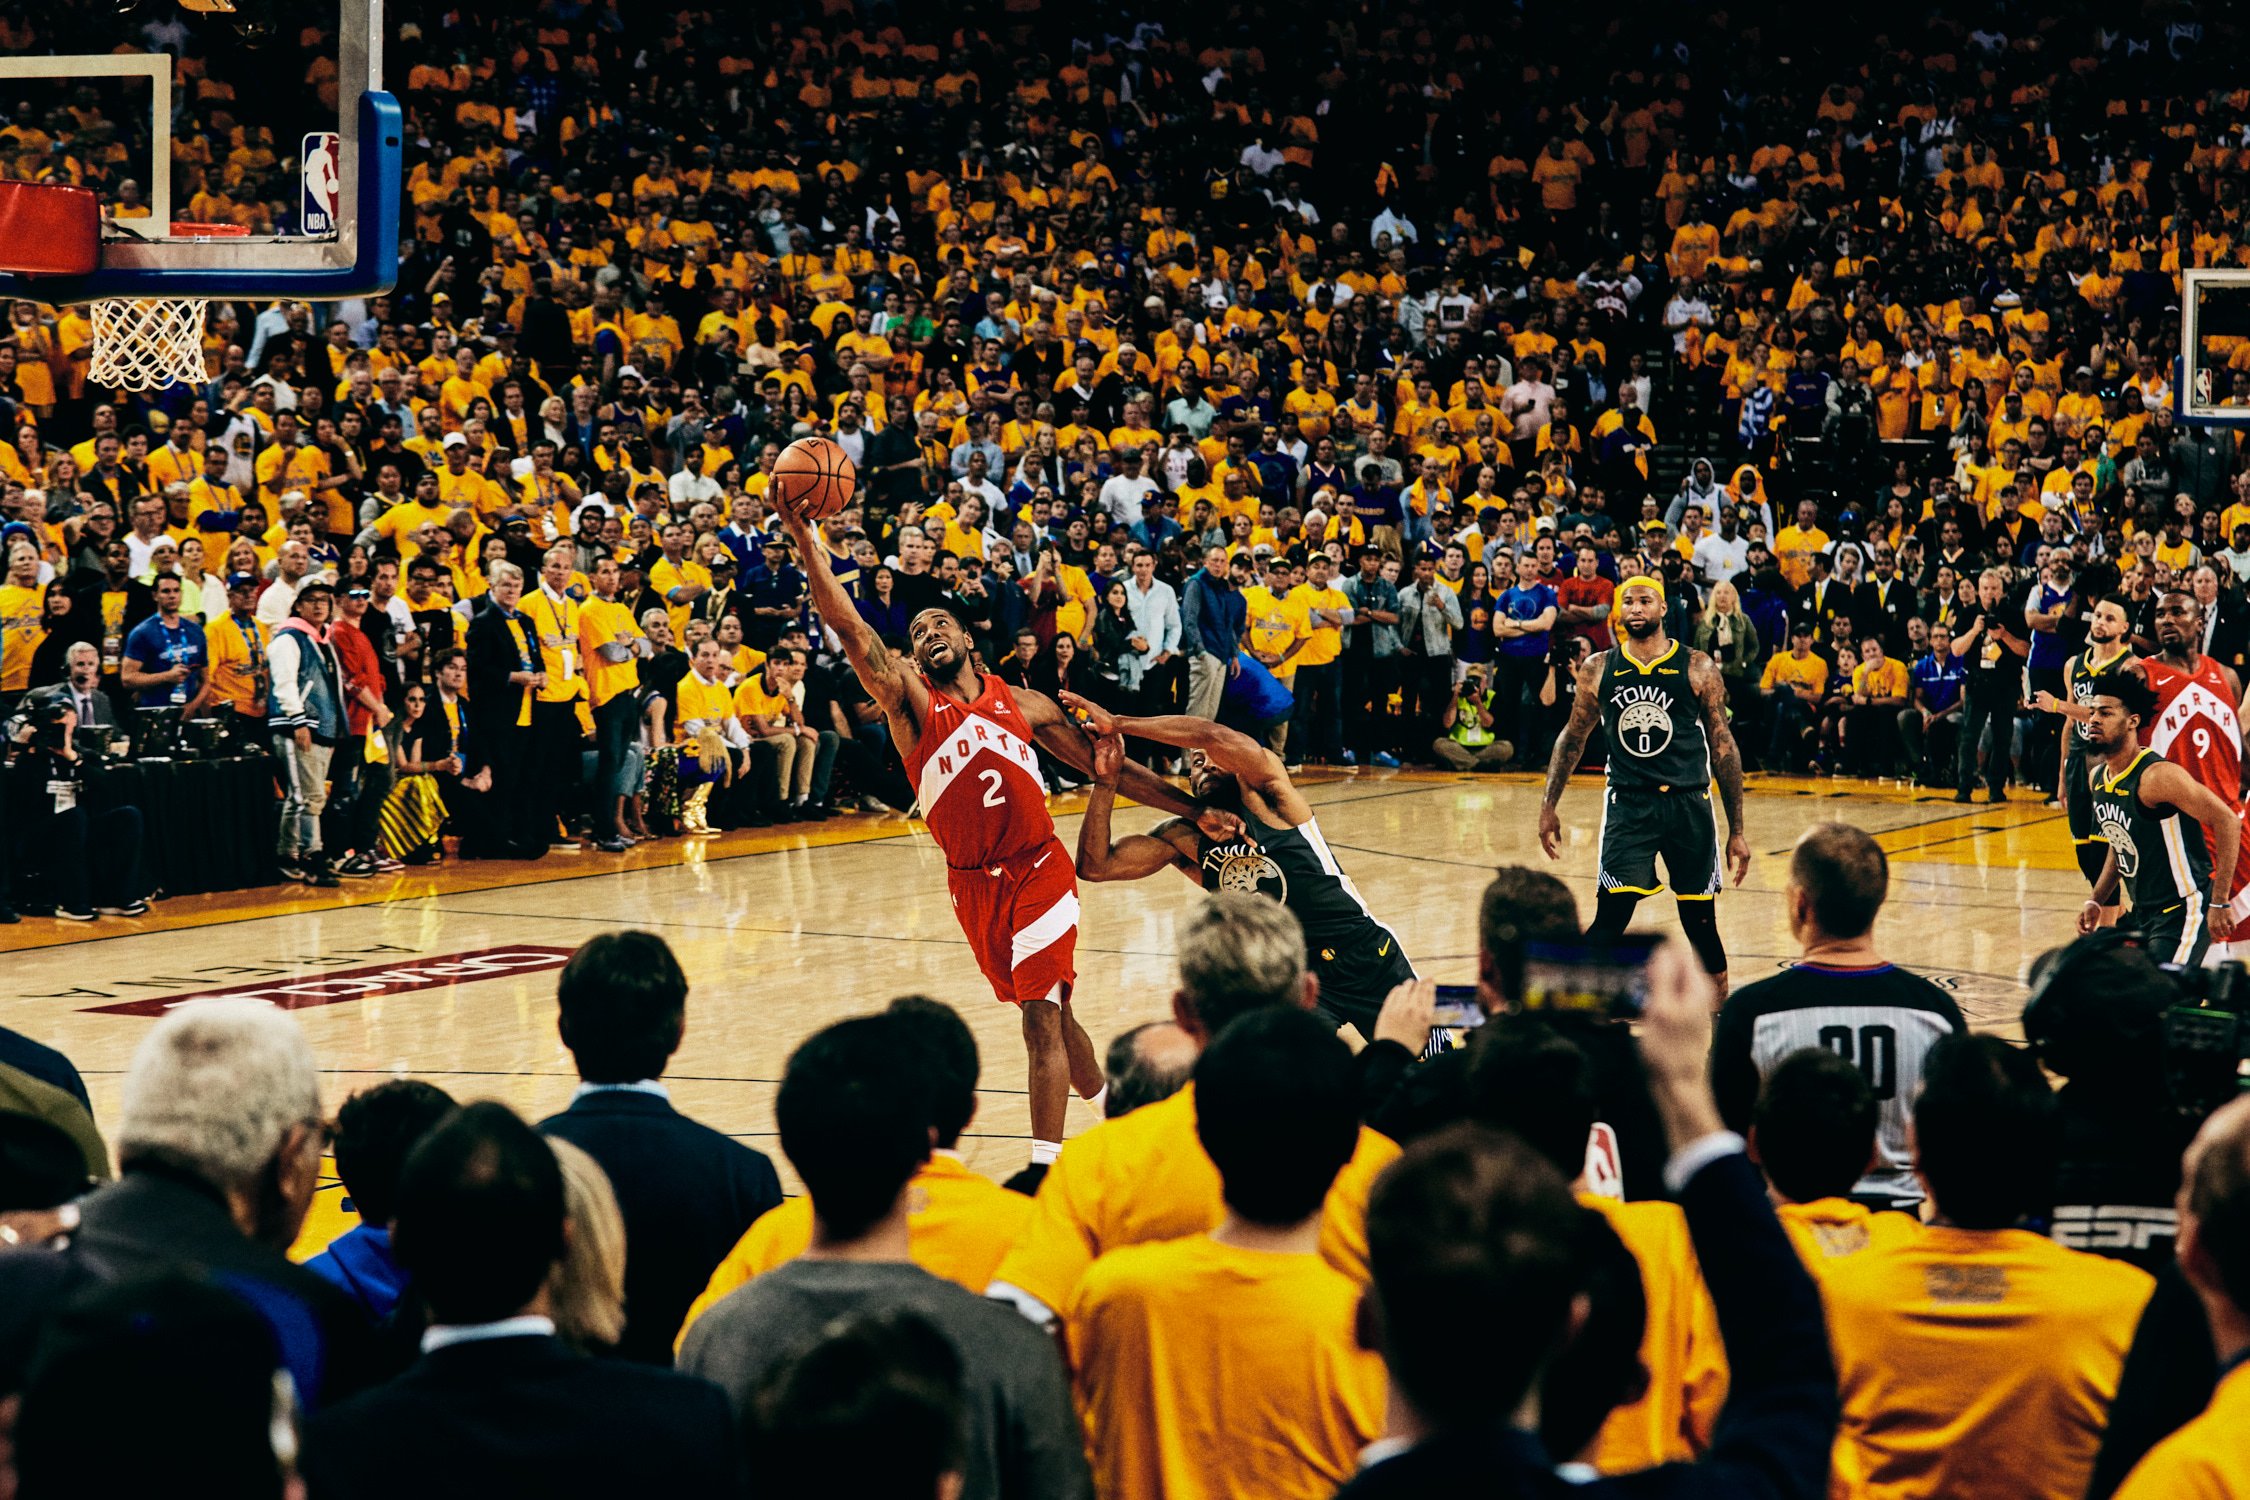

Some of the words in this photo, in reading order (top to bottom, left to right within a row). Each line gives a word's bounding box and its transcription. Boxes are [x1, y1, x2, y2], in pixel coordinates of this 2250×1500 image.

[307, 213, 326, 230] NBA
[1610, 685, 1674, 711] TOWN
[2165, 692, 2231, 731] NORTH
[938, 725, 1029, 775] NORTH
[1639, 734, 1650, 752] 0
[2192, 728, 2210, 759] 9
[978, 769, 1006, 808] 2
[18, 944, 423, 999] ARENA
[2050, 1205, 2178, 1249] ESP
